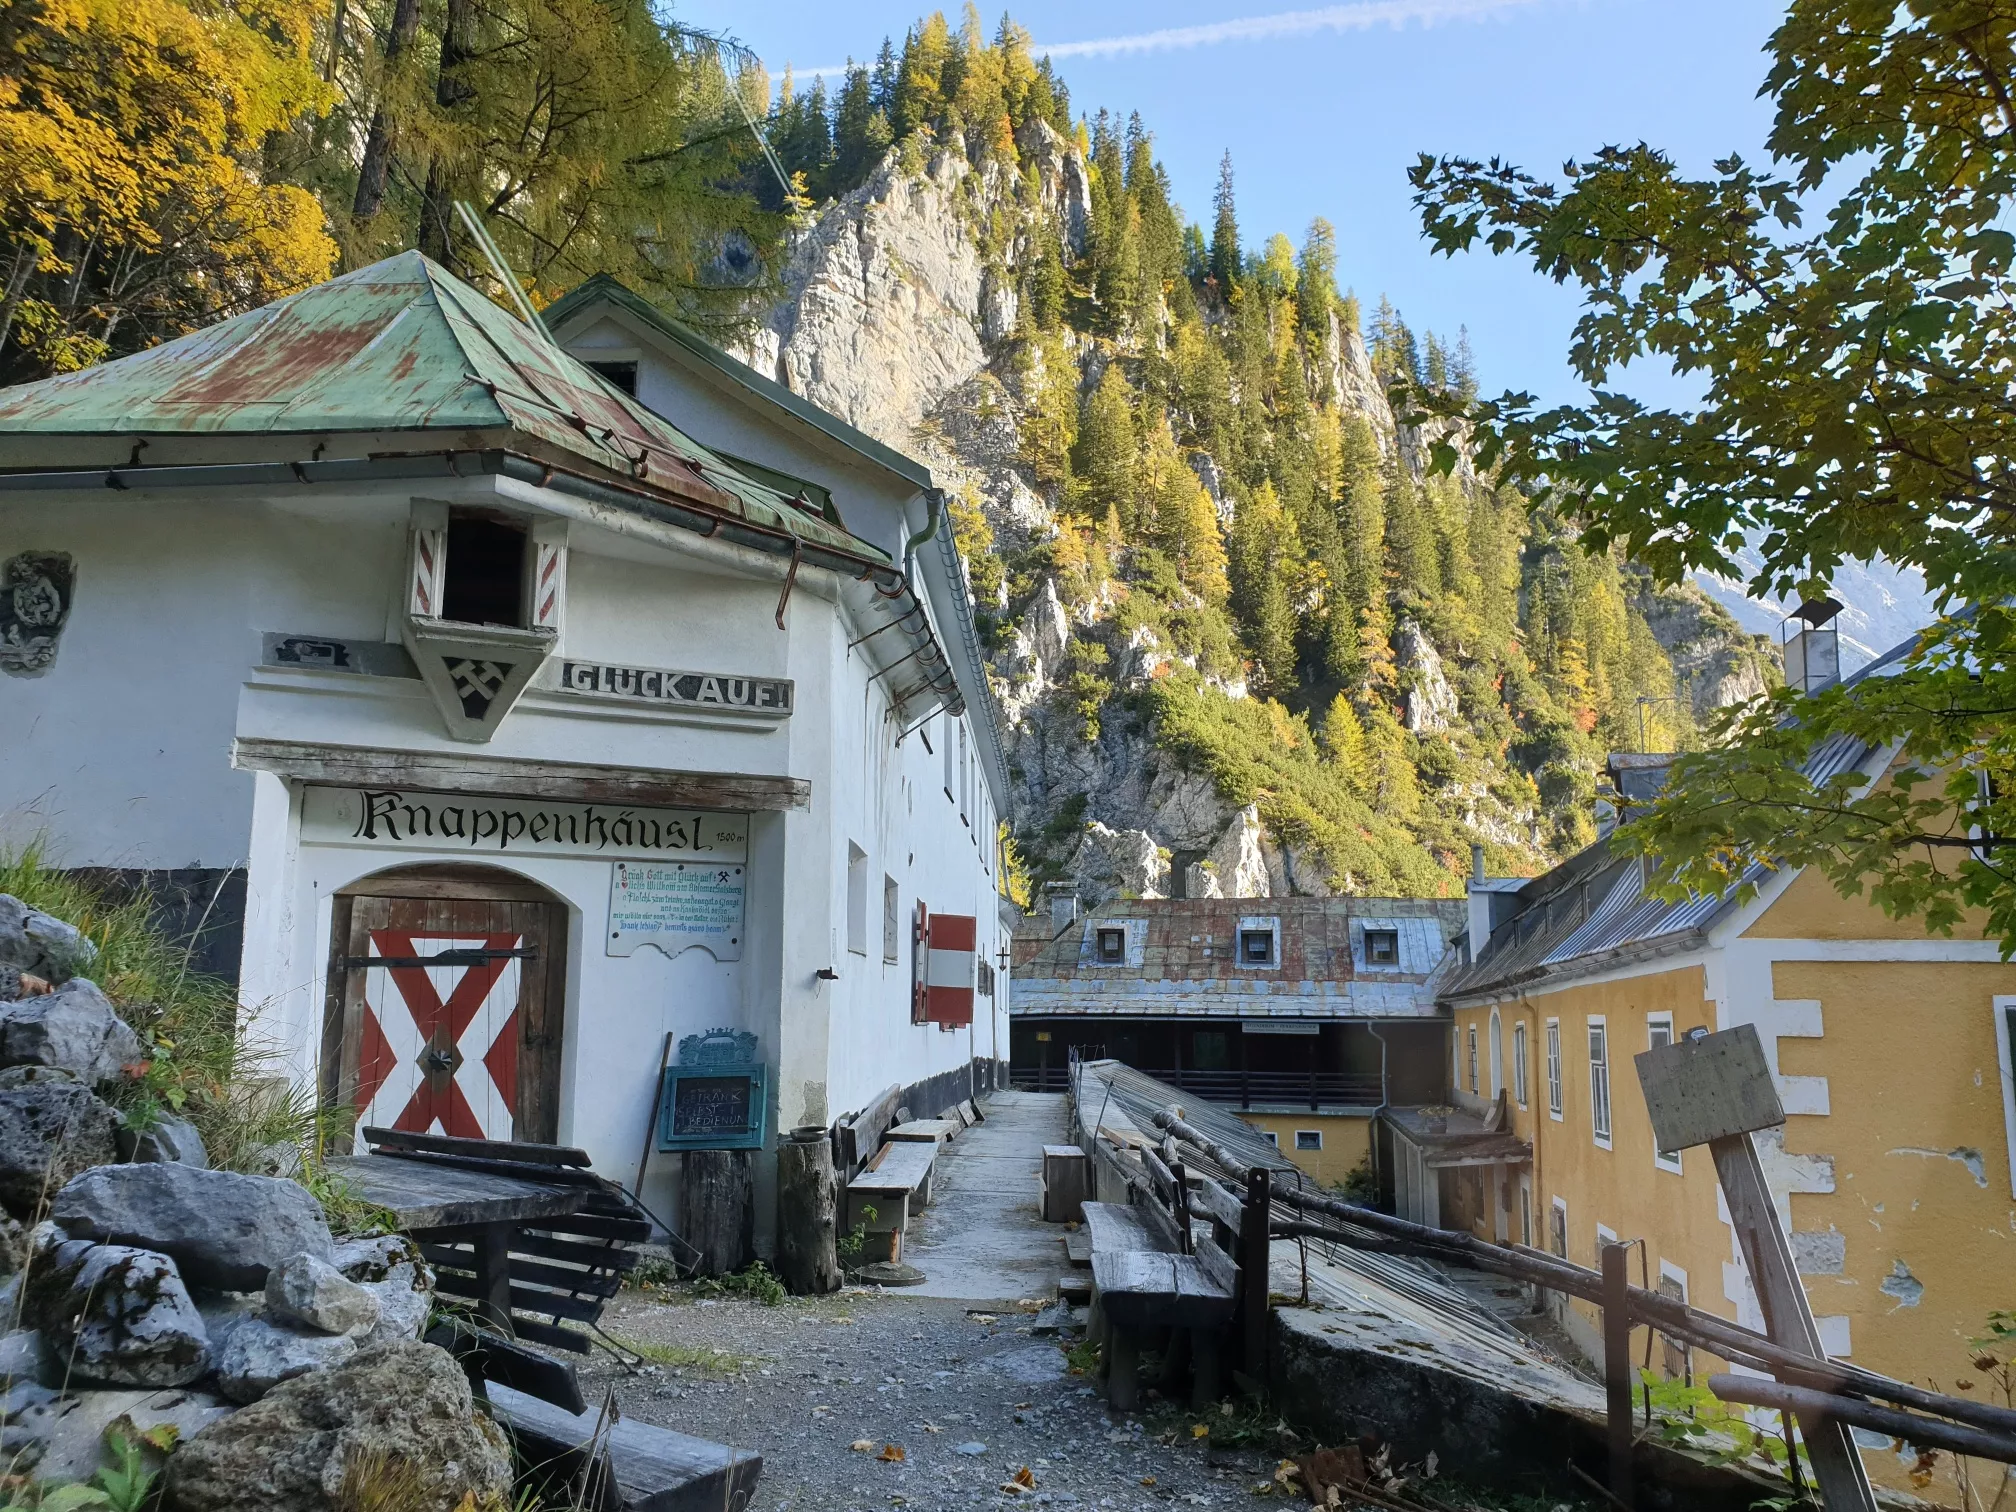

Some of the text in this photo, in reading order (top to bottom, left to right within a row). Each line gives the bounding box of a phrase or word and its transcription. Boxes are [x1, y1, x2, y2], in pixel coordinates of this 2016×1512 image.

[570, 664, 786, 708] GLÜCK AUF!
[352, 790, 714, 852] Knappenhäusl
[716, 832, 736, 842] 1500
[647, 869, 663, 880] Gott
[665, 871, 676, 880] mit
